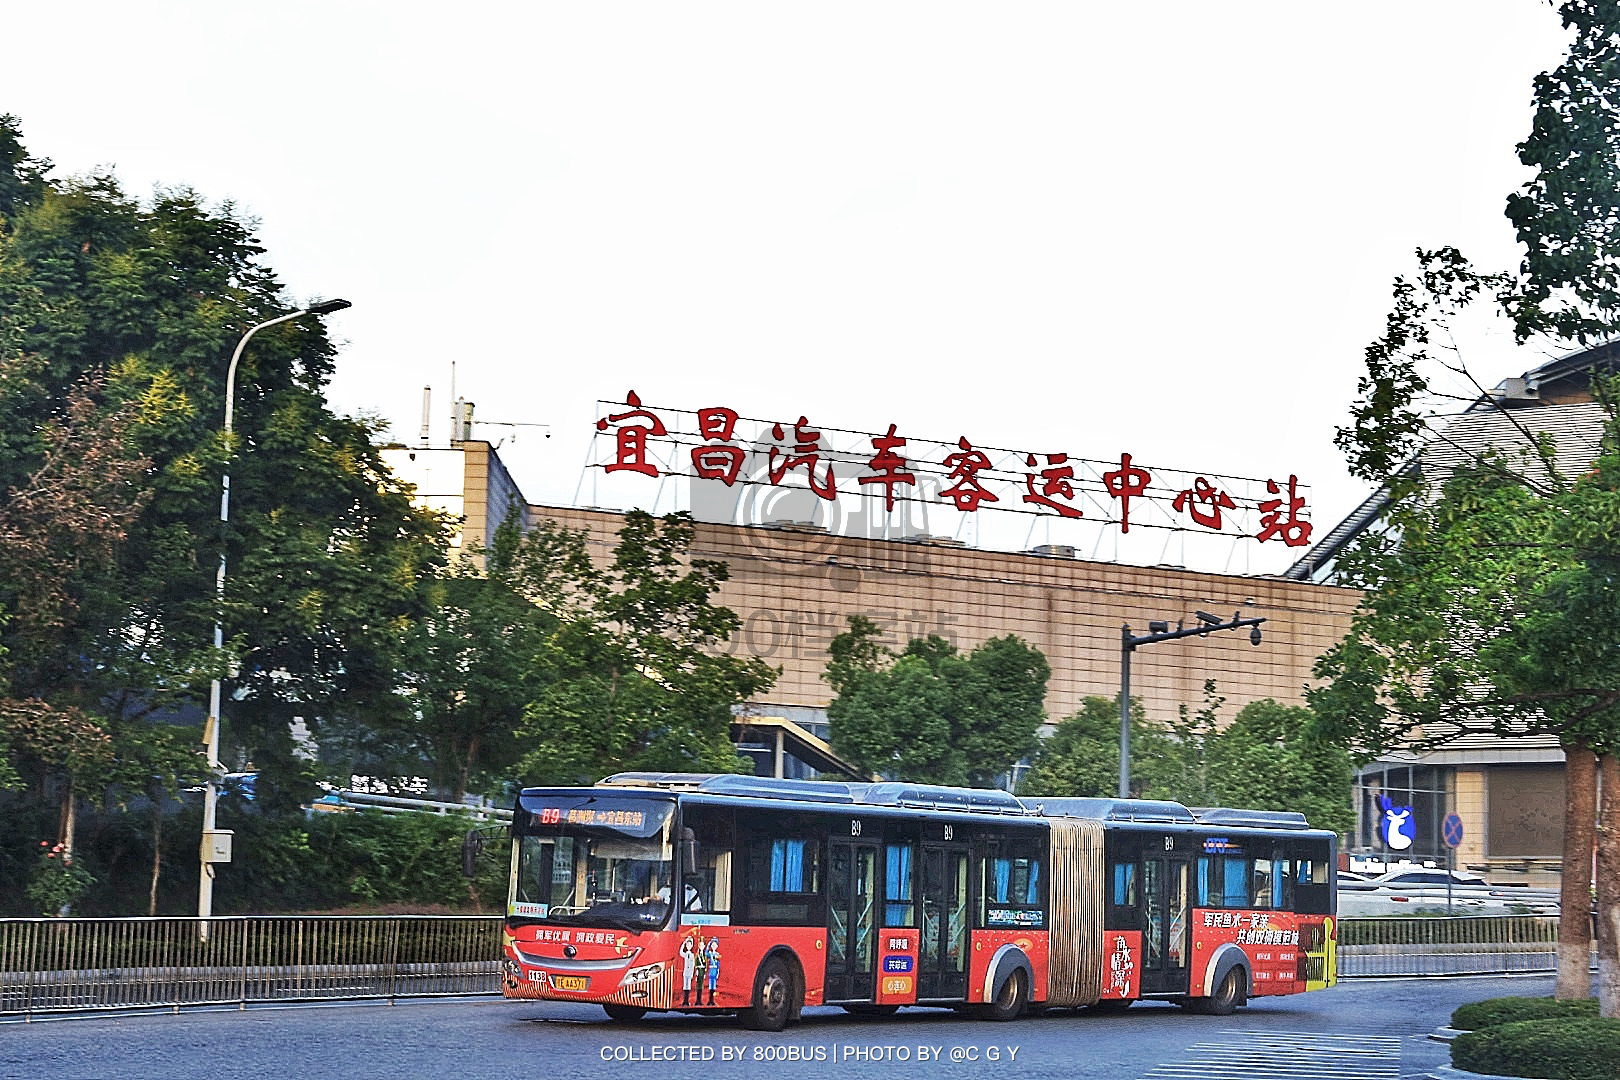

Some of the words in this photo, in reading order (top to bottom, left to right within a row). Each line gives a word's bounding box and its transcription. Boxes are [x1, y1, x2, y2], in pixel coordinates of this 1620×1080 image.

[596, 390, 1312, 547] 宜昌汽车客运中心站
[542, 808, 560, 824] B9
[851, 819, 861, 836] B9
[944, 825, 953, 841] B9
[1165, 836, 1174, 851] B9
[1204, 912, 1270, 929] 军民鱼水一家亲
